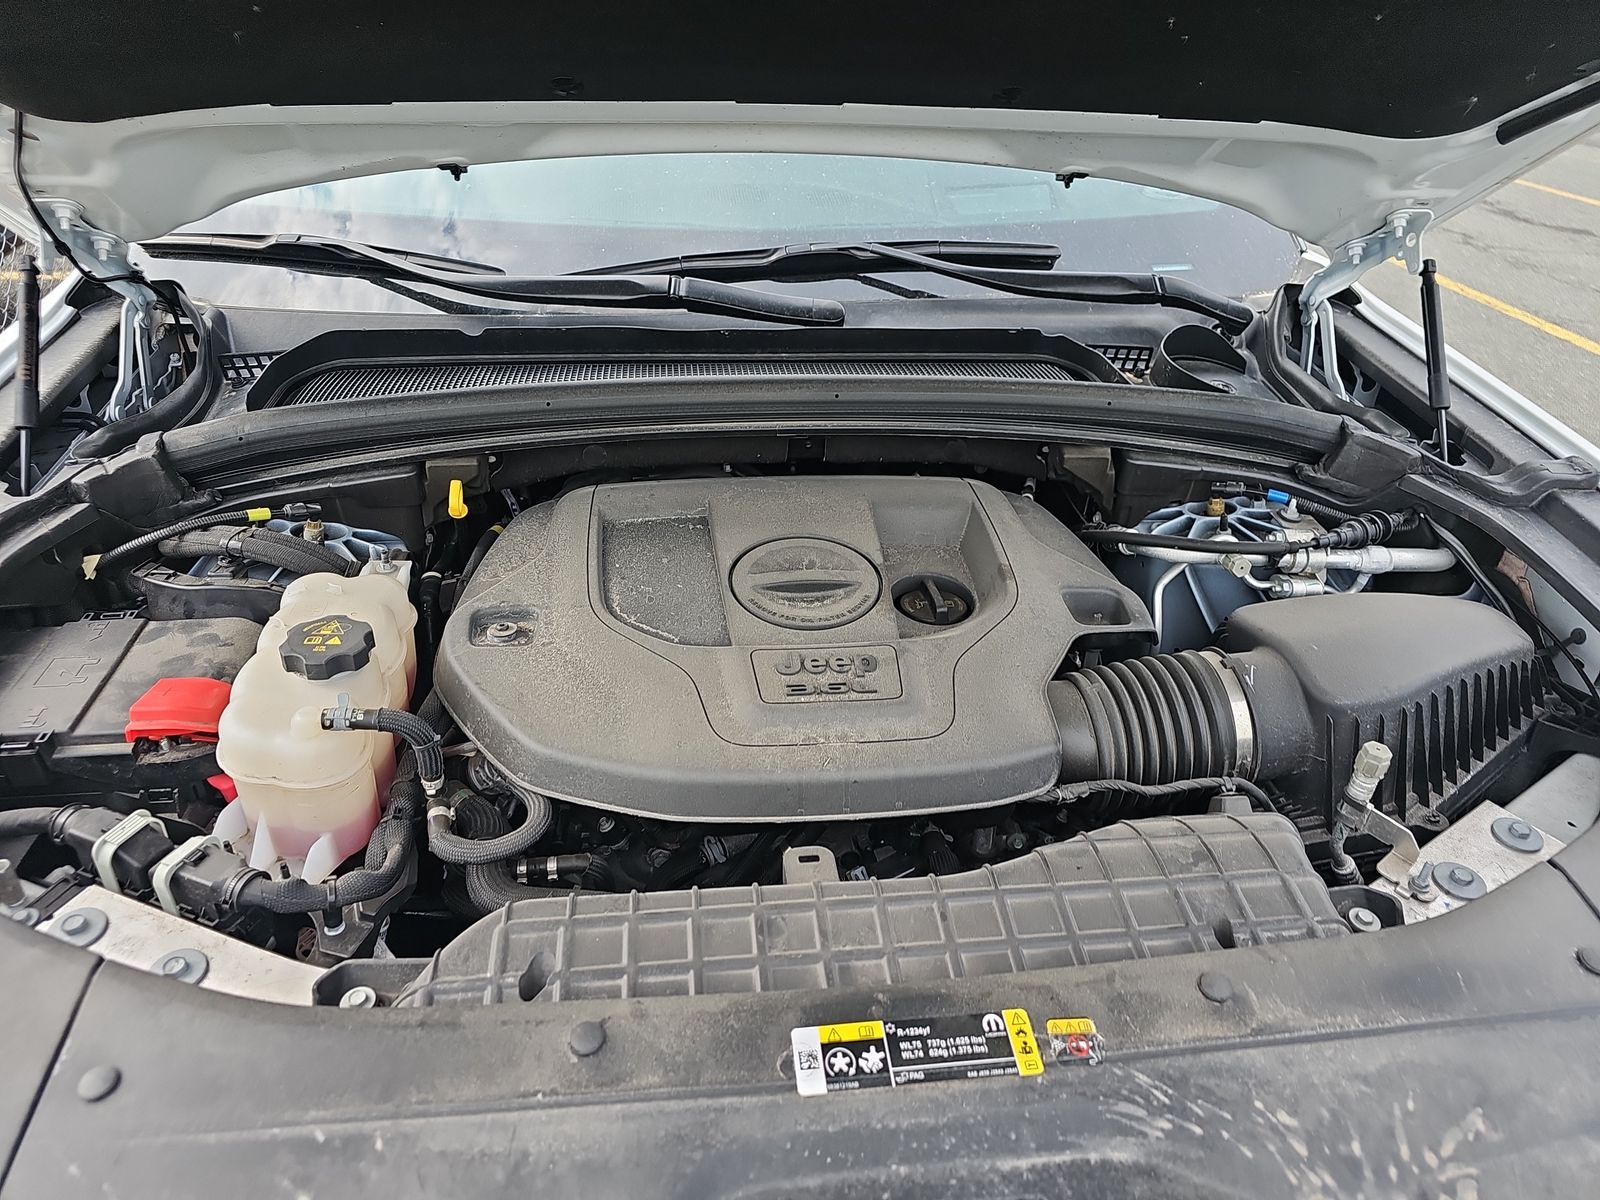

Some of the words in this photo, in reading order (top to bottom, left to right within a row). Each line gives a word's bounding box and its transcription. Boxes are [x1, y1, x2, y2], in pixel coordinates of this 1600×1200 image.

[776, 653, 877, 679] Jeep
[786, 681, 877, 697] 3.6L
[899, 1040, 923, 1050] WL75
[927, 1038, 947, 1049] 737g
[971, 1035, 986, 1044] lbs)
[974, 1044, 989, 1054] lbs)
